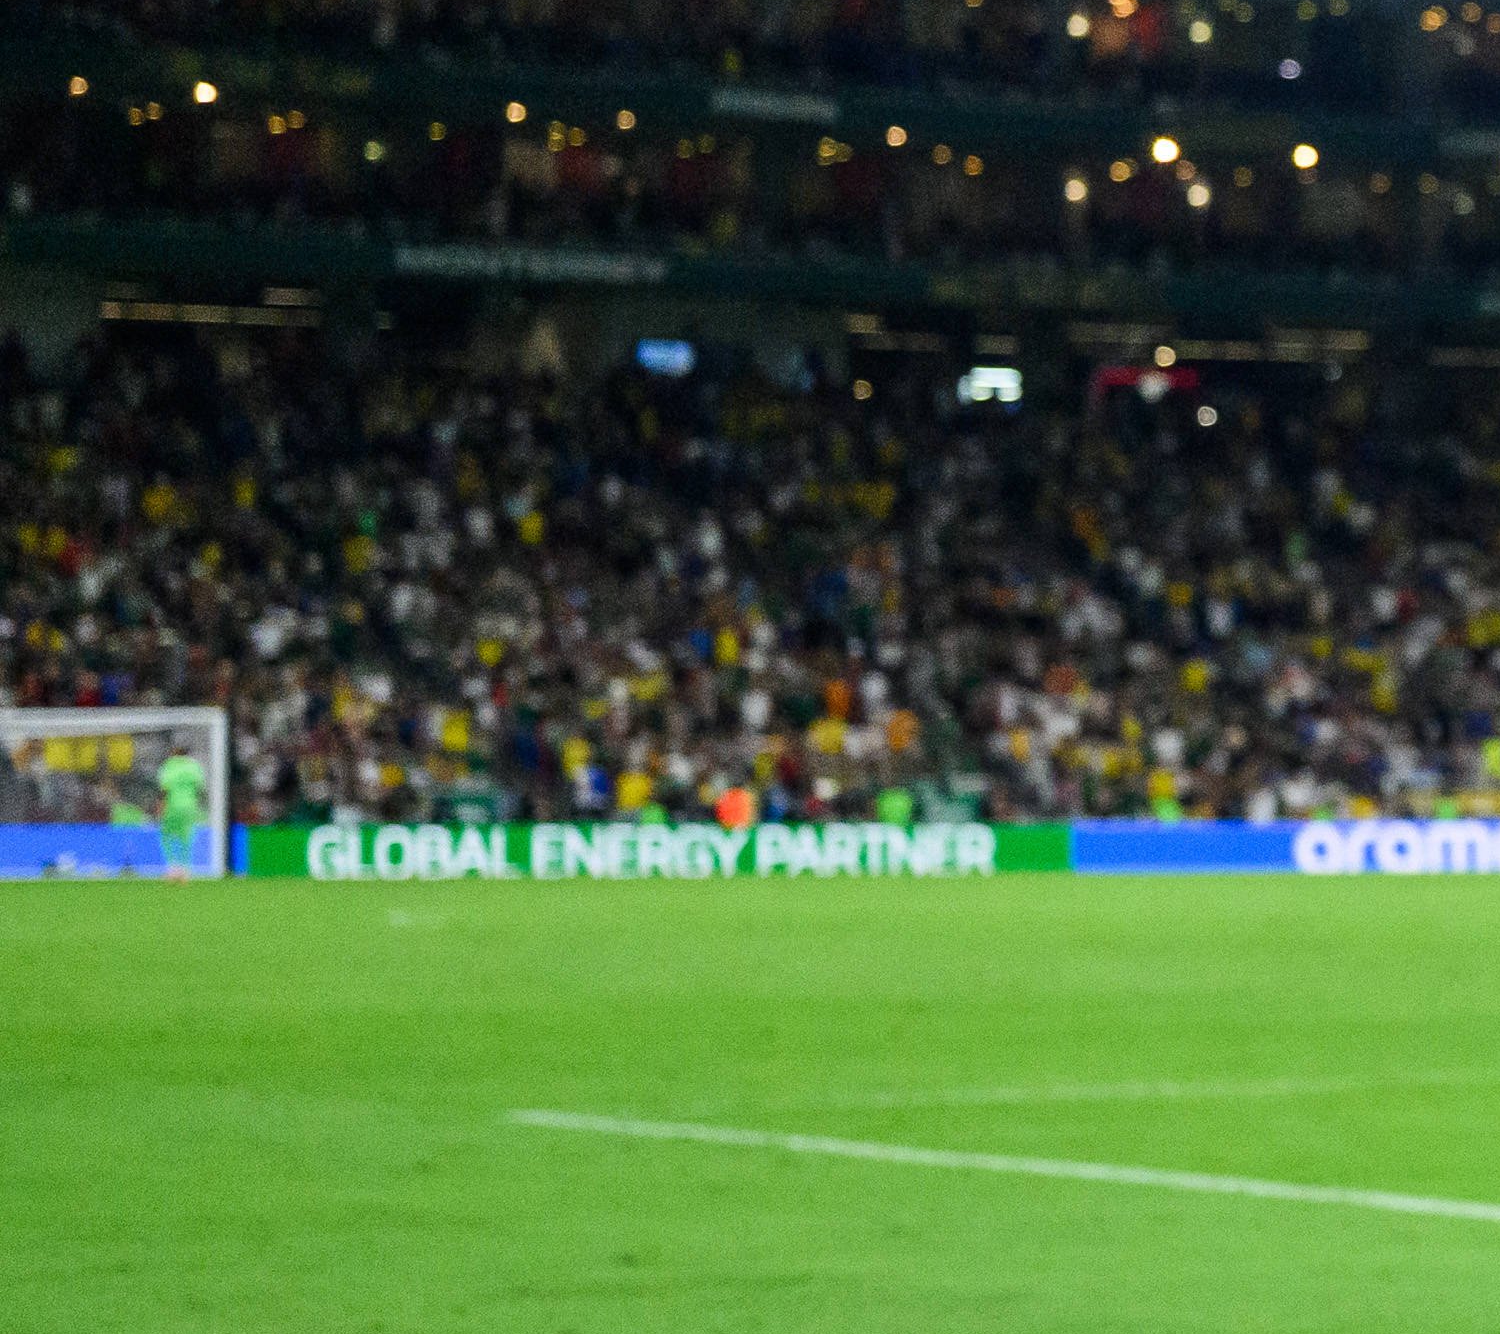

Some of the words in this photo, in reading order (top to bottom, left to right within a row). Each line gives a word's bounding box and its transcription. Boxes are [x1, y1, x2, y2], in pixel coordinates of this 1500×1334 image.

[308, 824, 521, 879] GLOBAL
[531, 824, 750, 878] ENERGY
[755, 822, 997, 878] PARTNER
